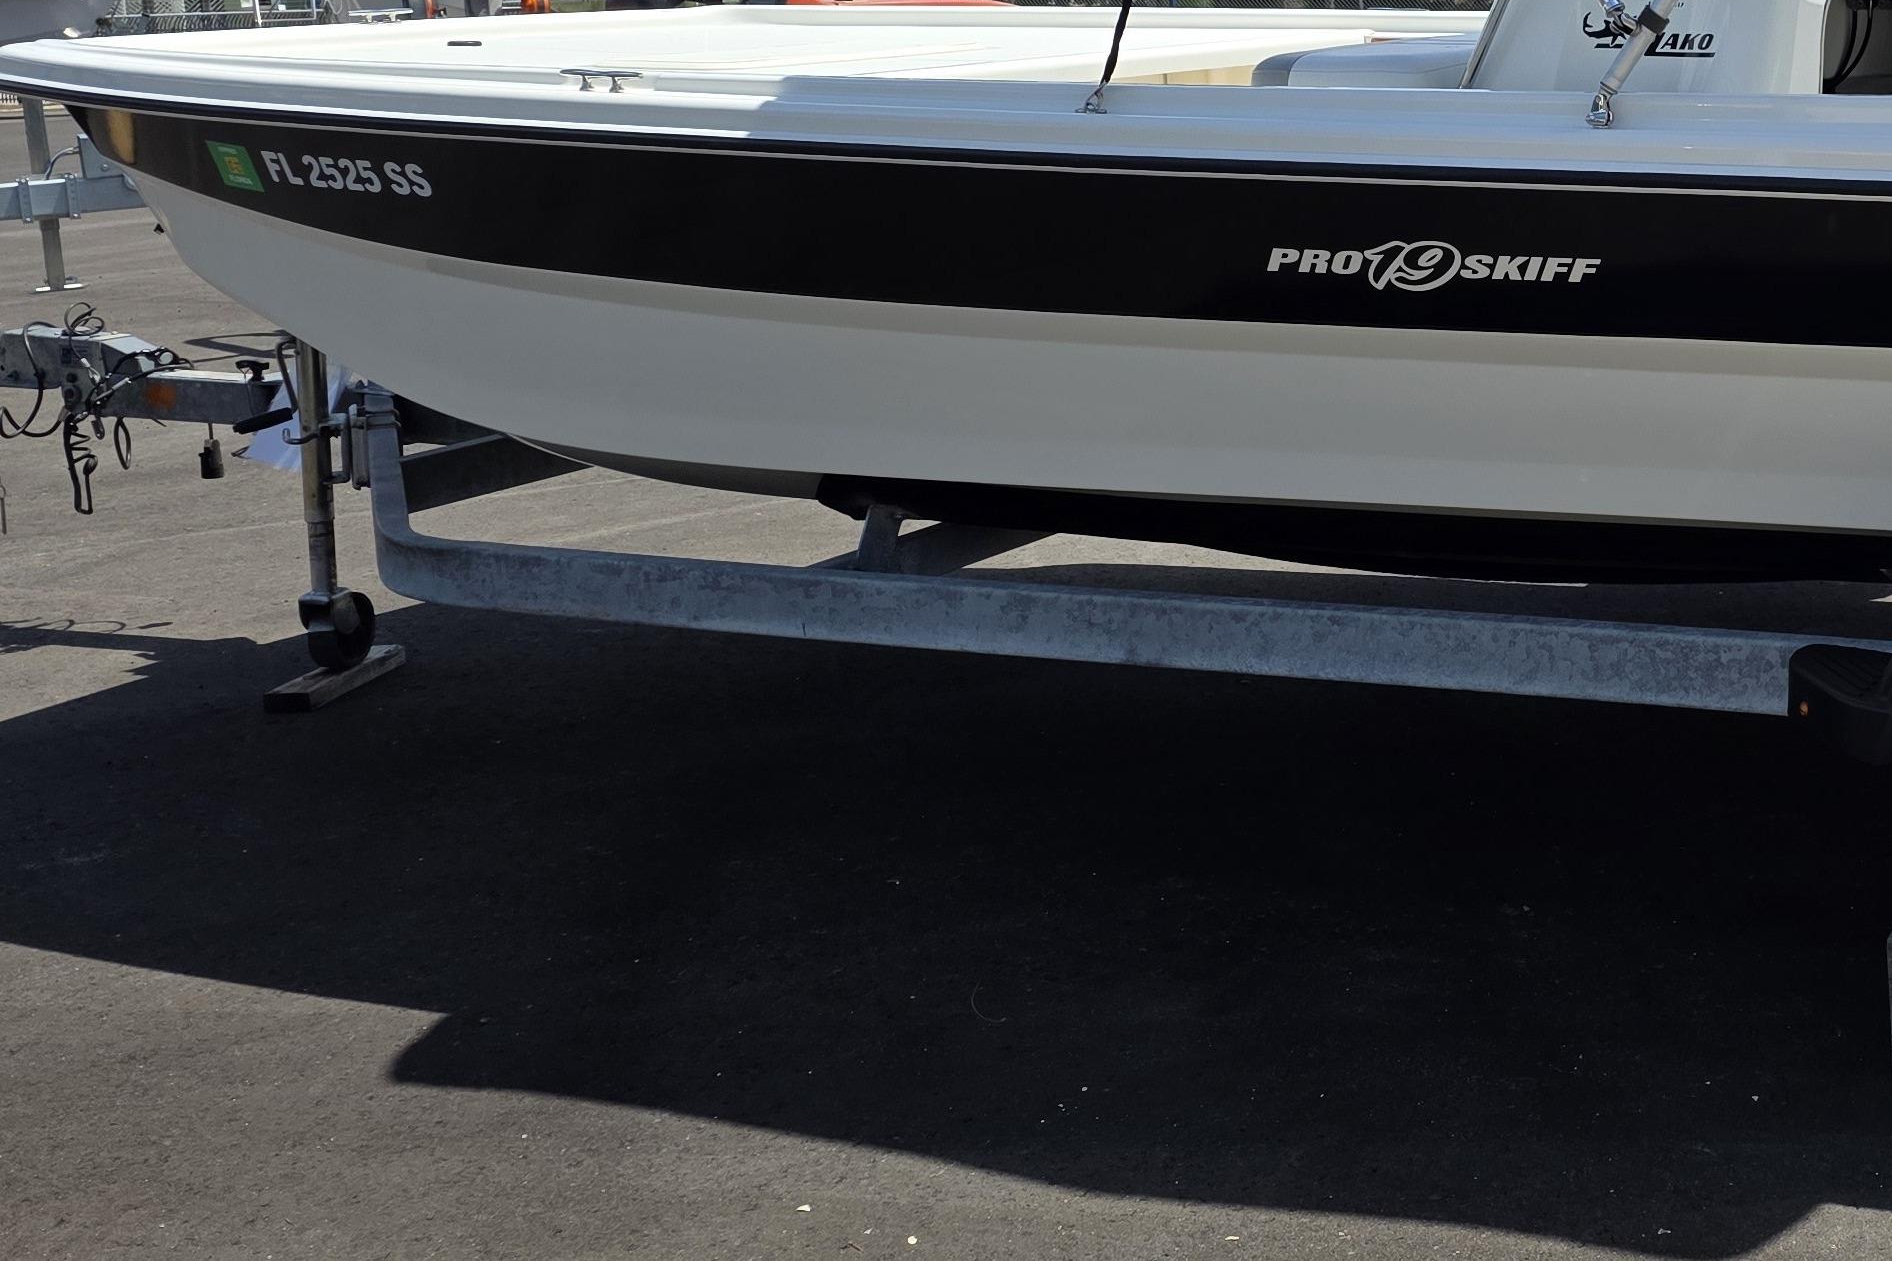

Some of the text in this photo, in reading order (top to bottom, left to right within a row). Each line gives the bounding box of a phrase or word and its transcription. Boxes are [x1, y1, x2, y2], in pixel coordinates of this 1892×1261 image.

[260, 150, 304, 186] FL
[301, 154, 382, 193] 2525
[383, 161, 433, 197] SS
[1266, 240, 1602, 292] PRO 19 SKIFF
